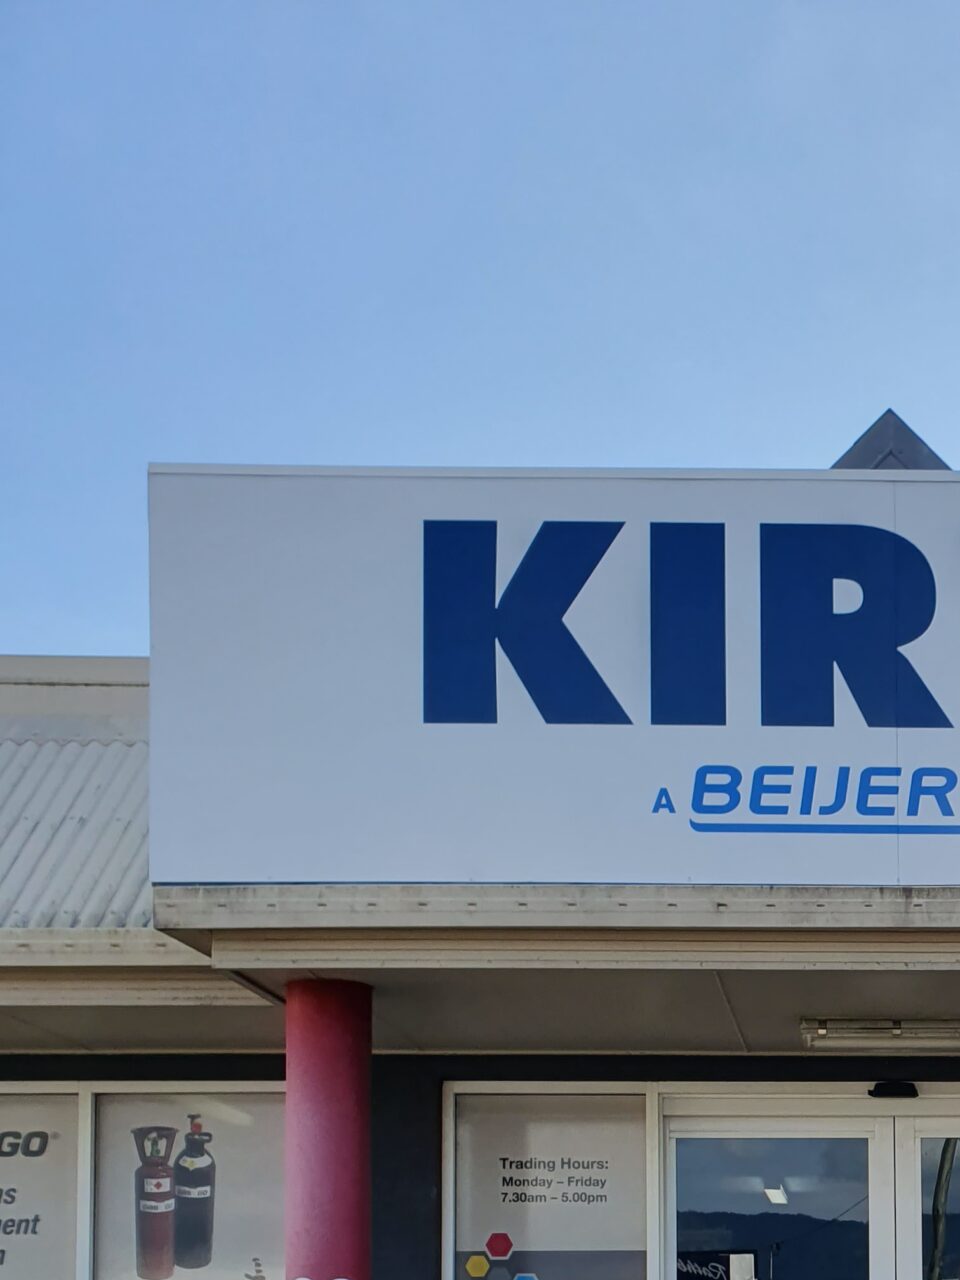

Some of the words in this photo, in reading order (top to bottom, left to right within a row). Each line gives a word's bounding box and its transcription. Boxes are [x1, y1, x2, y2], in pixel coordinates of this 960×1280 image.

[651, 787, 676, 814] A
[691, 764, 958, 818] BEIJER
[499, 1157, 555, 1172] Trading
[560, 1157, 609, 1170] Hours:
[502, 1176, 553, 1189] Monday
[567, 1176, 607, 1189] Friday
[501, 1192, 547, 1203] 7.30am
[561, 1192, 608, 1204] 5.00pm
[0, 1214, 40, 1235] ent
